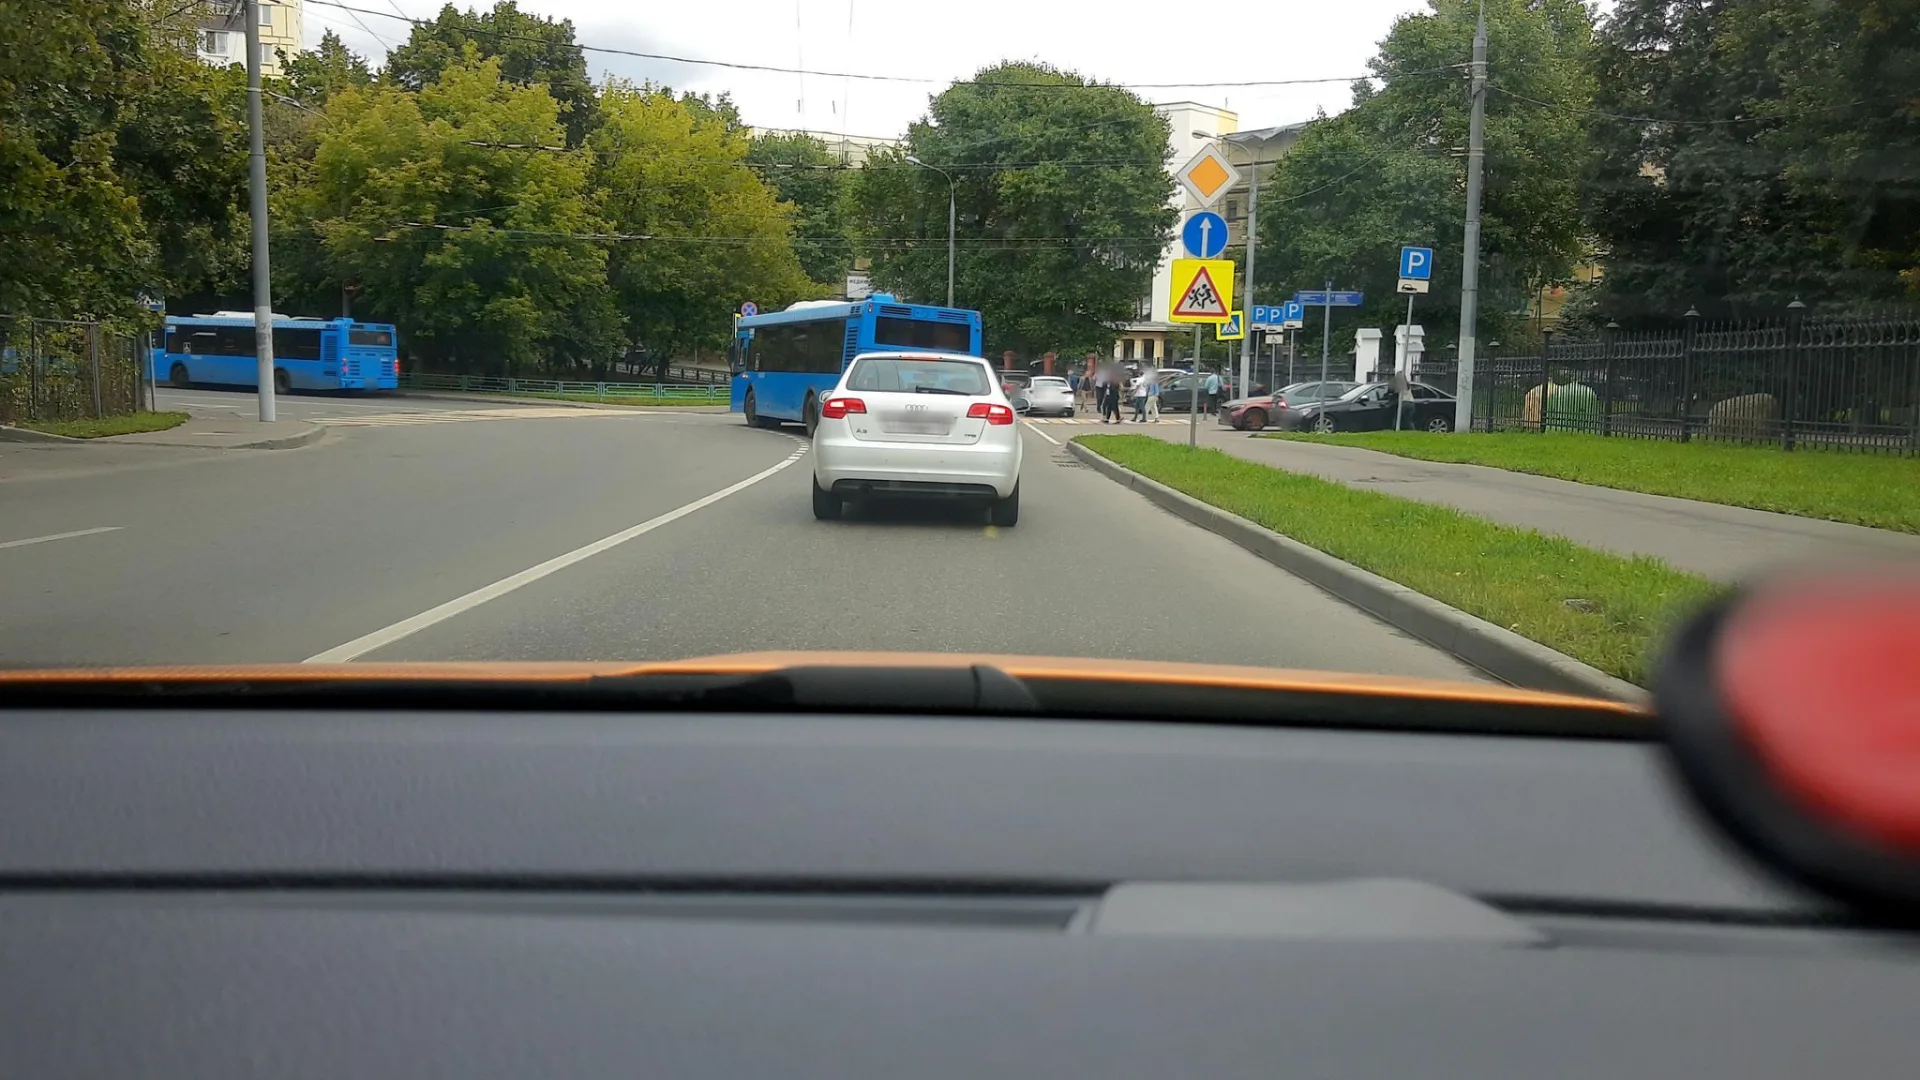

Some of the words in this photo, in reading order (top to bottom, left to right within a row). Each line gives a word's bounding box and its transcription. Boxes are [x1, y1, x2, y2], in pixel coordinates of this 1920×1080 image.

[1408, 251, 1425, 274] P
[1255, 307, 1265, 320] P
[1270, 309, 1280, 322] P
[1289, 303, 1299, 317] P
